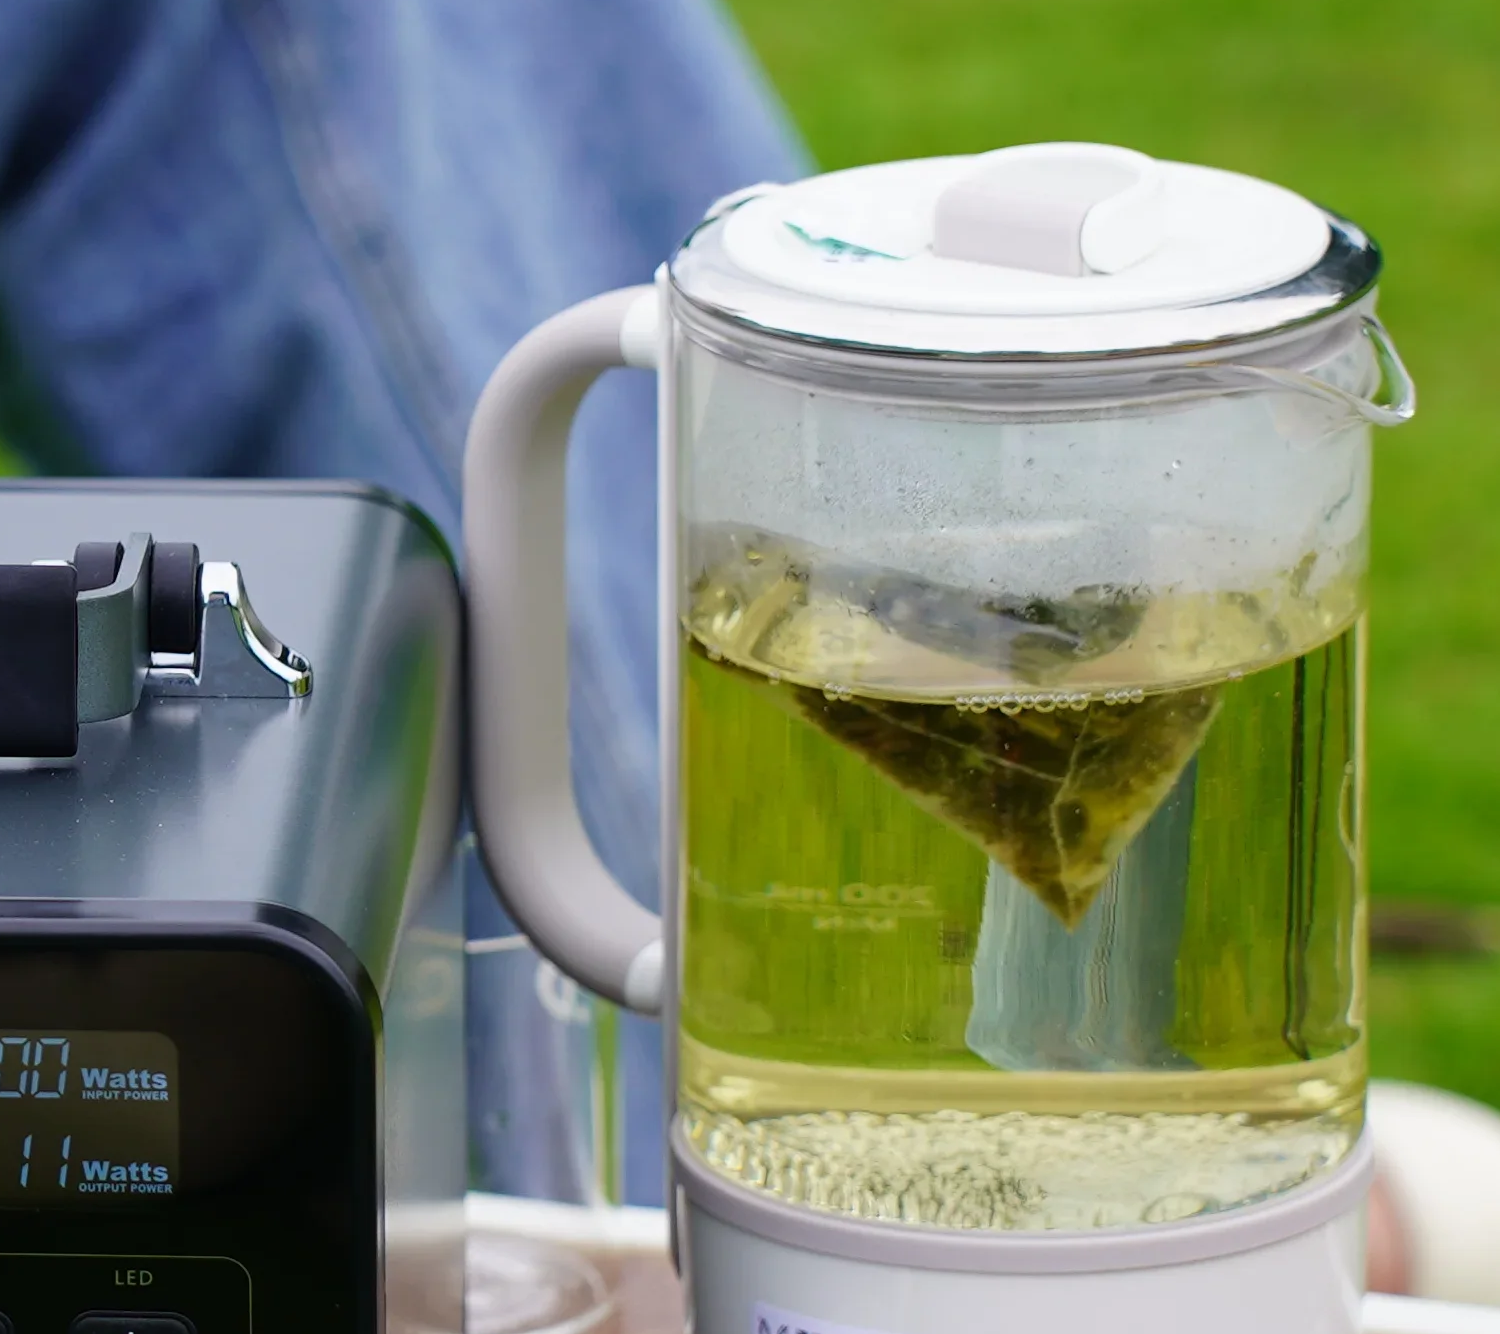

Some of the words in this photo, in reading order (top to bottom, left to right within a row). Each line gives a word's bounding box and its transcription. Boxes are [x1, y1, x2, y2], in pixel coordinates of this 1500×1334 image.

[82, 1068, 167, 1089] Watts
[83, 1090, 120, 1099] INPUT
[124, 1091, 168, 1100] POWER
[83, 1161, 168, 1182] Watts
[79, 1183, 126, 1193] OUTPUT
[131, 1184, 172, 1194] POWER
[116, 1270, 152, 1285] LED
